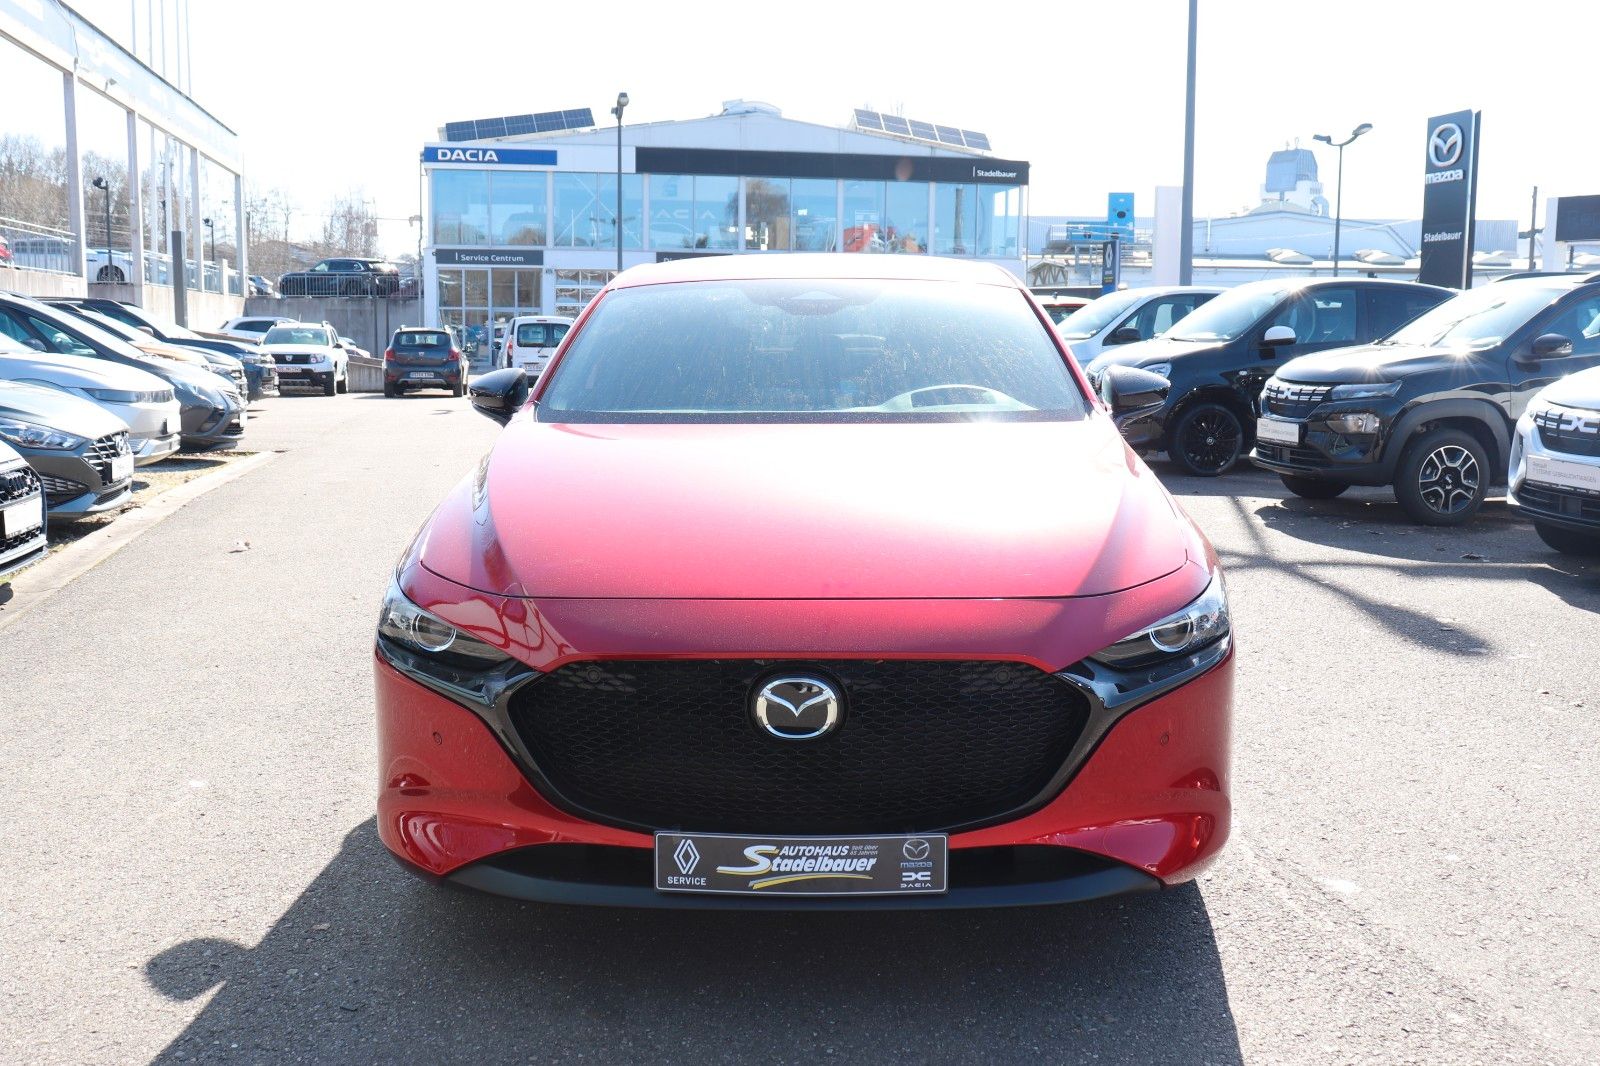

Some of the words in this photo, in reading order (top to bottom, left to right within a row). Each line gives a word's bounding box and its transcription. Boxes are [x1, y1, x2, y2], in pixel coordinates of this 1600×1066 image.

[437, 149, 499, 162] DACIA
[976, 169, 1017, 178] Stadelbauer
[1425, 169, 1464, 184] mazda
[1424, 231, 1462, 242] Stadelbauer
[461, 253, 489, 263] Service
[491, 253, 524, 263] Centrum
[778, 845, 849, 856] AUTOHAUS
[716, 845, 877, 875] Stadelbauer
[667, 876, 707, 886] SERVICE
